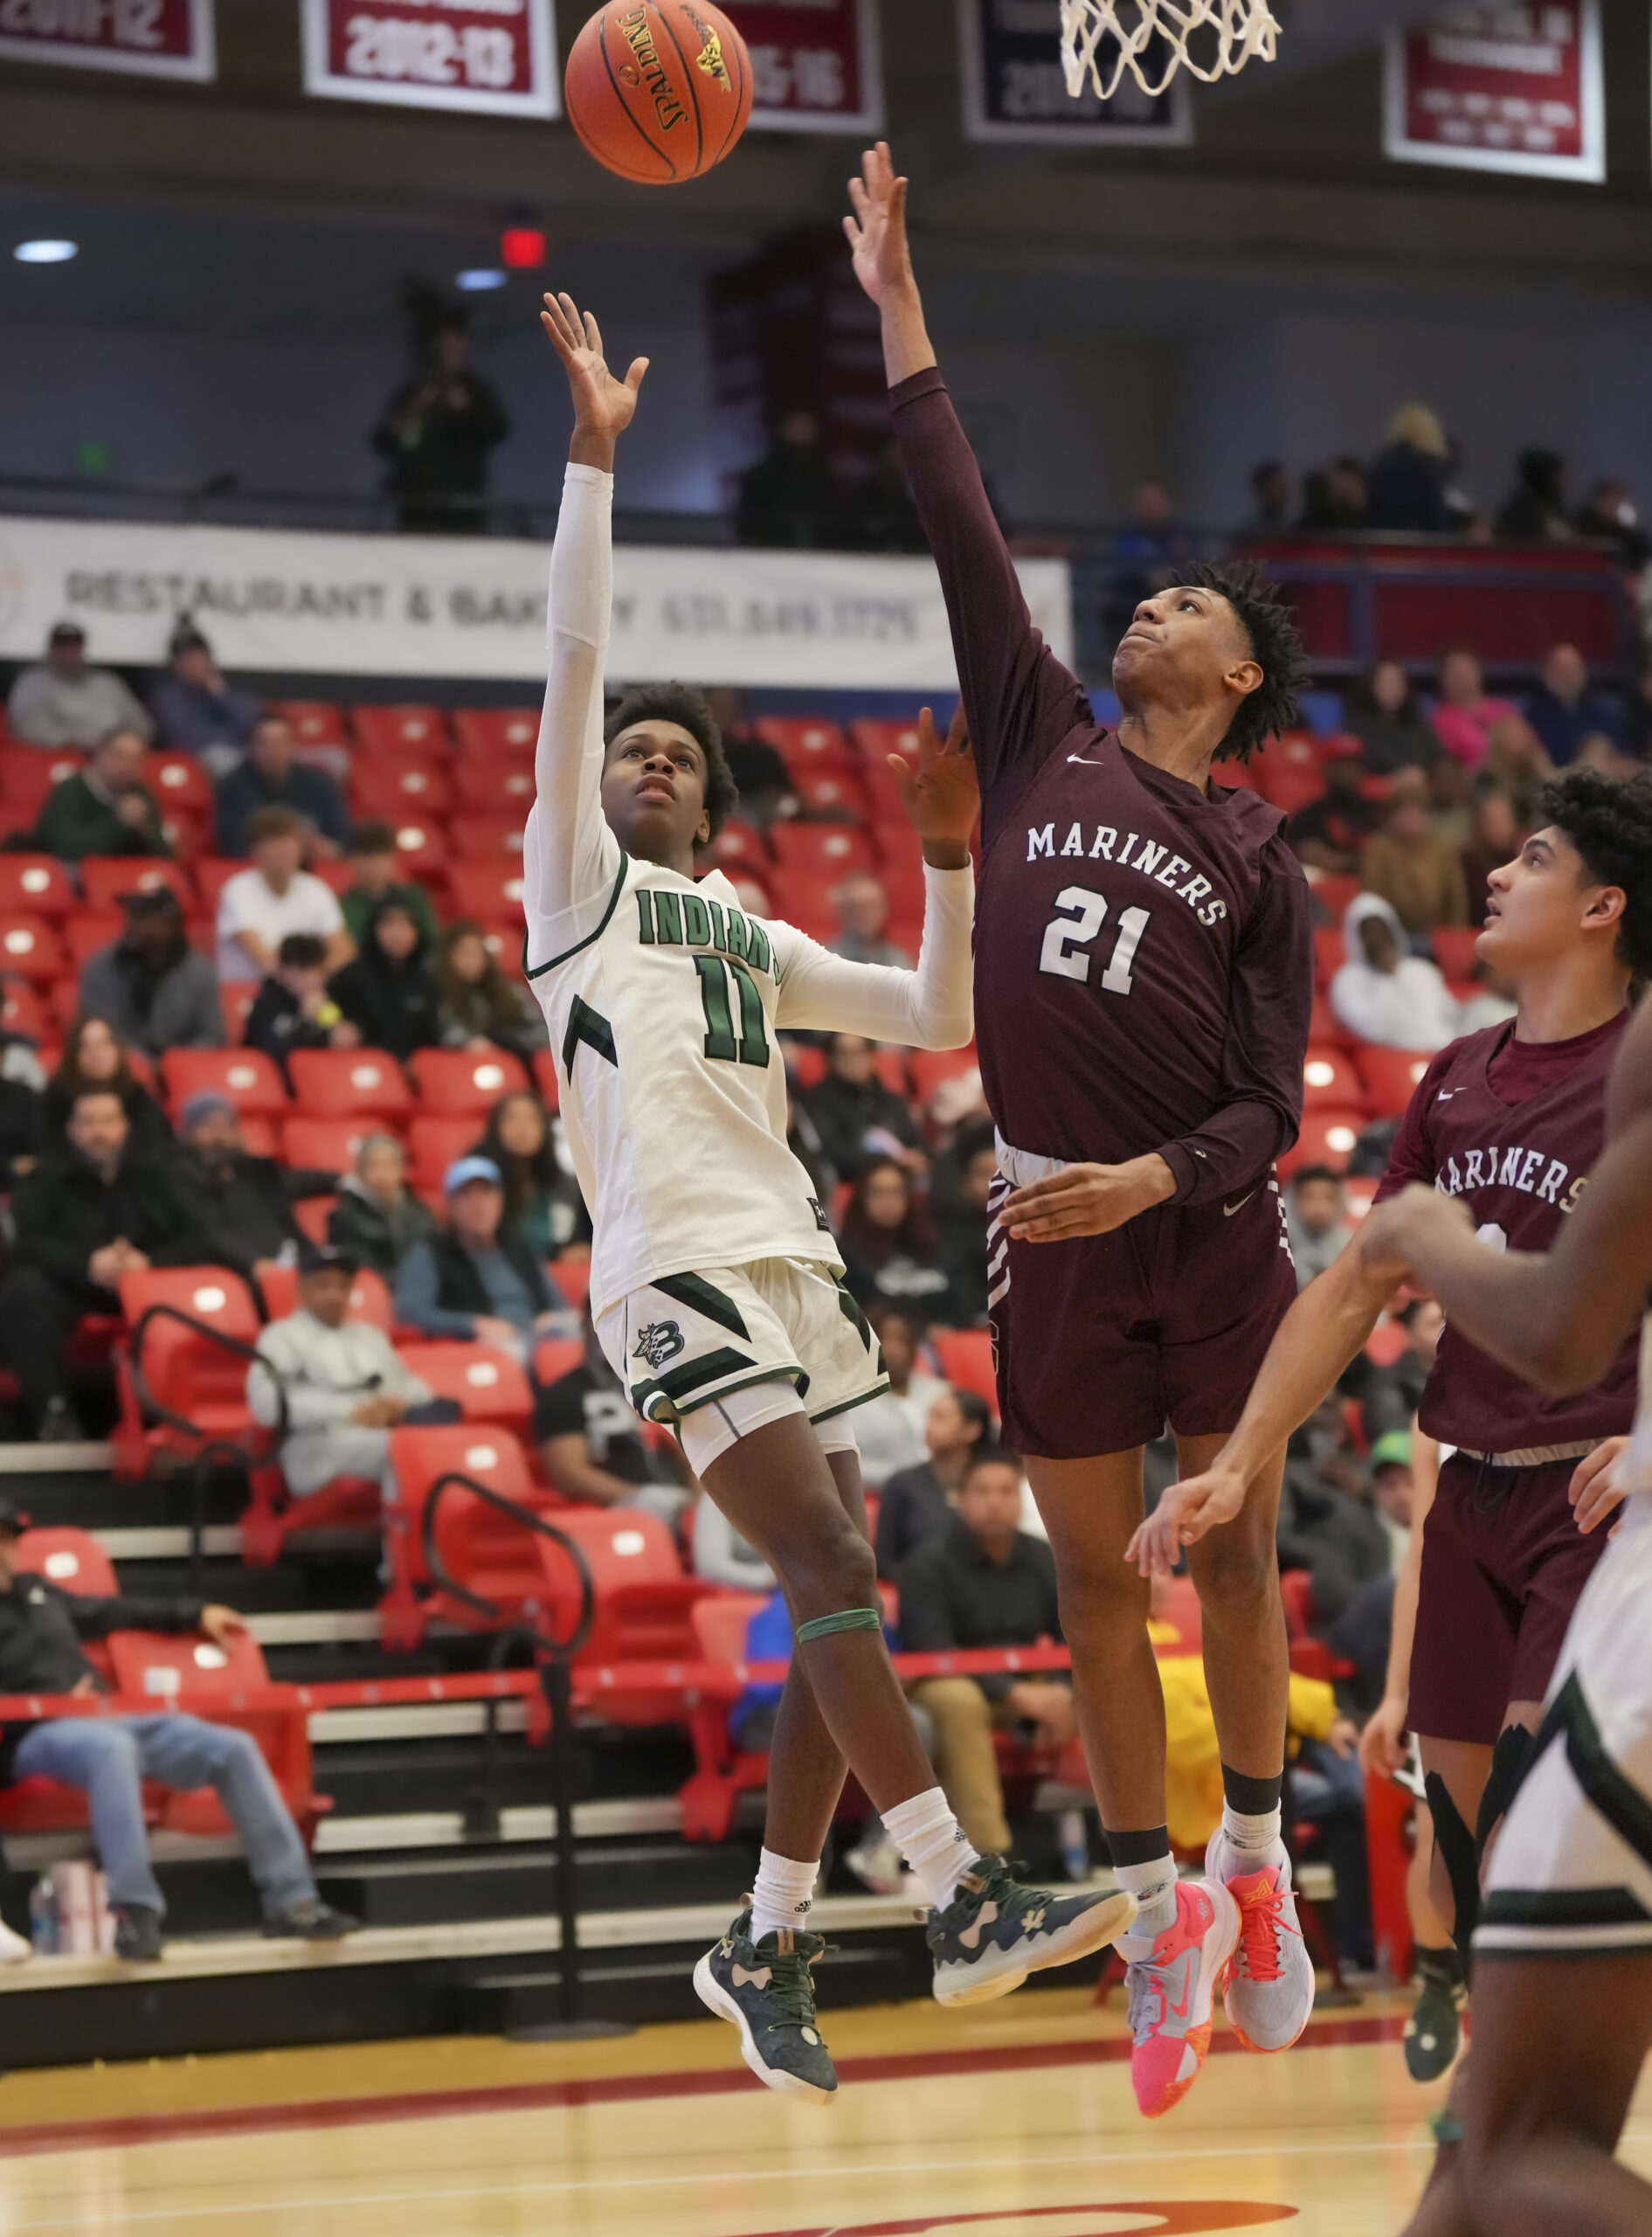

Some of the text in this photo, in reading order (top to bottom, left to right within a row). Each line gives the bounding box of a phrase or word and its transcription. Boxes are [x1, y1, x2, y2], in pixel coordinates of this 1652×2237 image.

[346, 14, 515, 88] 2012-13
[616, 8, 689, 131] SPALDING
[65, 571, 385, 622] RESTAURANT
[404, 588, 432, 626] &
[448, 589, 635, 631] BAKY
[1026, 822, 1227, 926] MARINERS
[1039, 885, 1151, 995] 21
[692, 954, 770, 1069] 11
